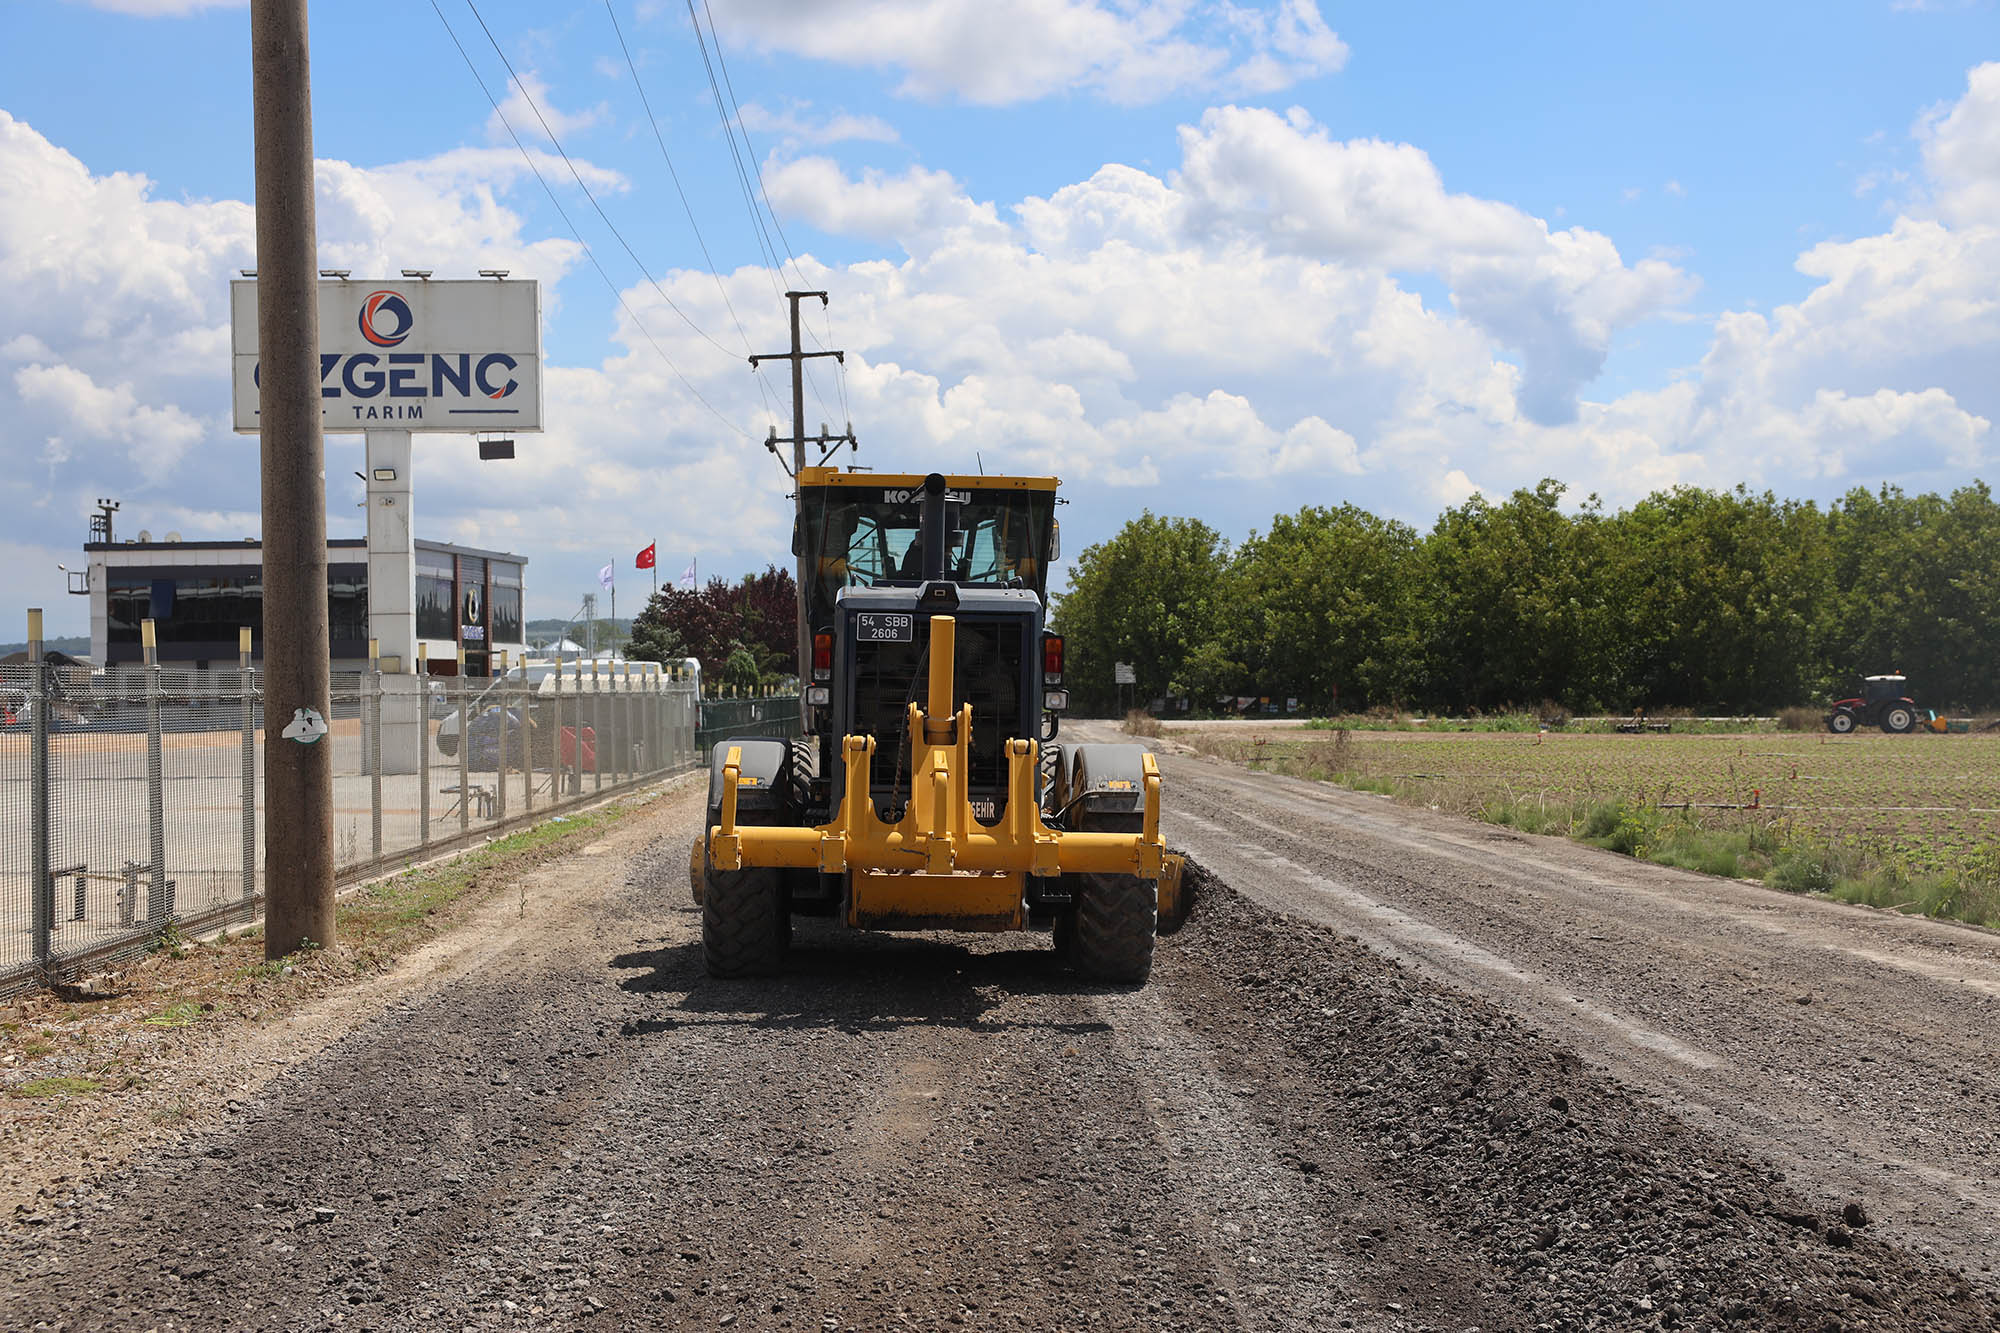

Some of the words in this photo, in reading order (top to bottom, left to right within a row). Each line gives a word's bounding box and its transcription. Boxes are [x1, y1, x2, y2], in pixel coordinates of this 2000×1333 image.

[352, 406, 424, 420] TARIM
[861, 615, 875, 627] 54
[884, 616, 909, 628] SBB
[871, 628, 898, 639] 2606
